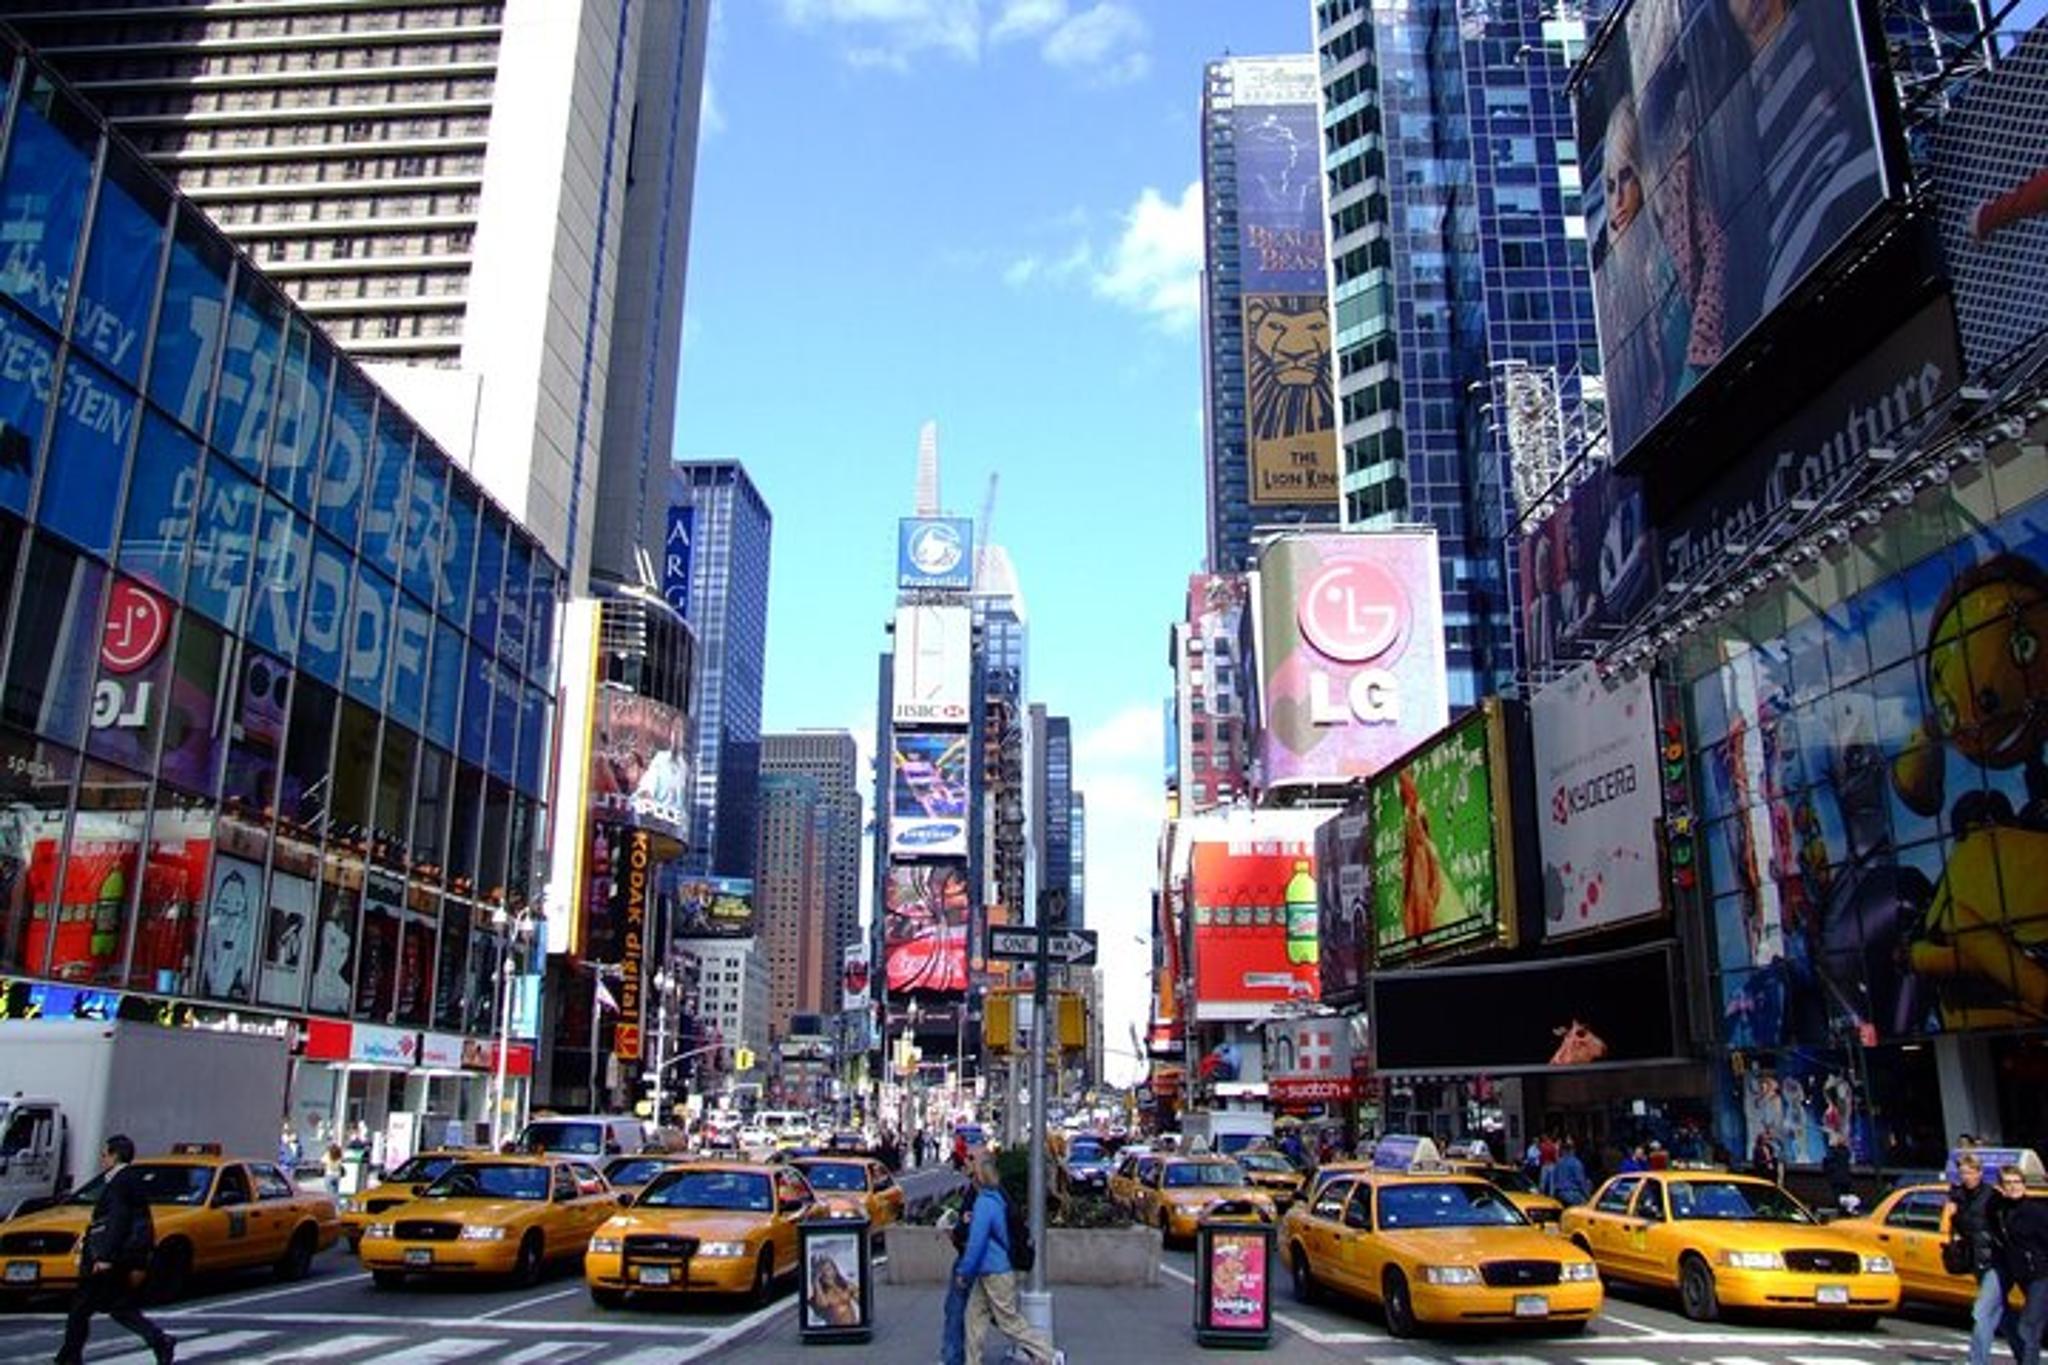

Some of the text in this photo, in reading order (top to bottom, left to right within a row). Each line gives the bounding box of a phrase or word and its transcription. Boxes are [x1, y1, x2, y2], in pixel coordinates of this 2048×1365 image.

[0, 314, 133, 446] IERSTEIN
[1291, 451, 1318, 465] THE
[897, 704, 940, 717] HSBC
[1311, 668, 1401, 727] LG
[627, 831, 648, 925] KODAK
[622, 931, 641, 1018] digital
[1002, 936, 1084, 954] ONE WAY
